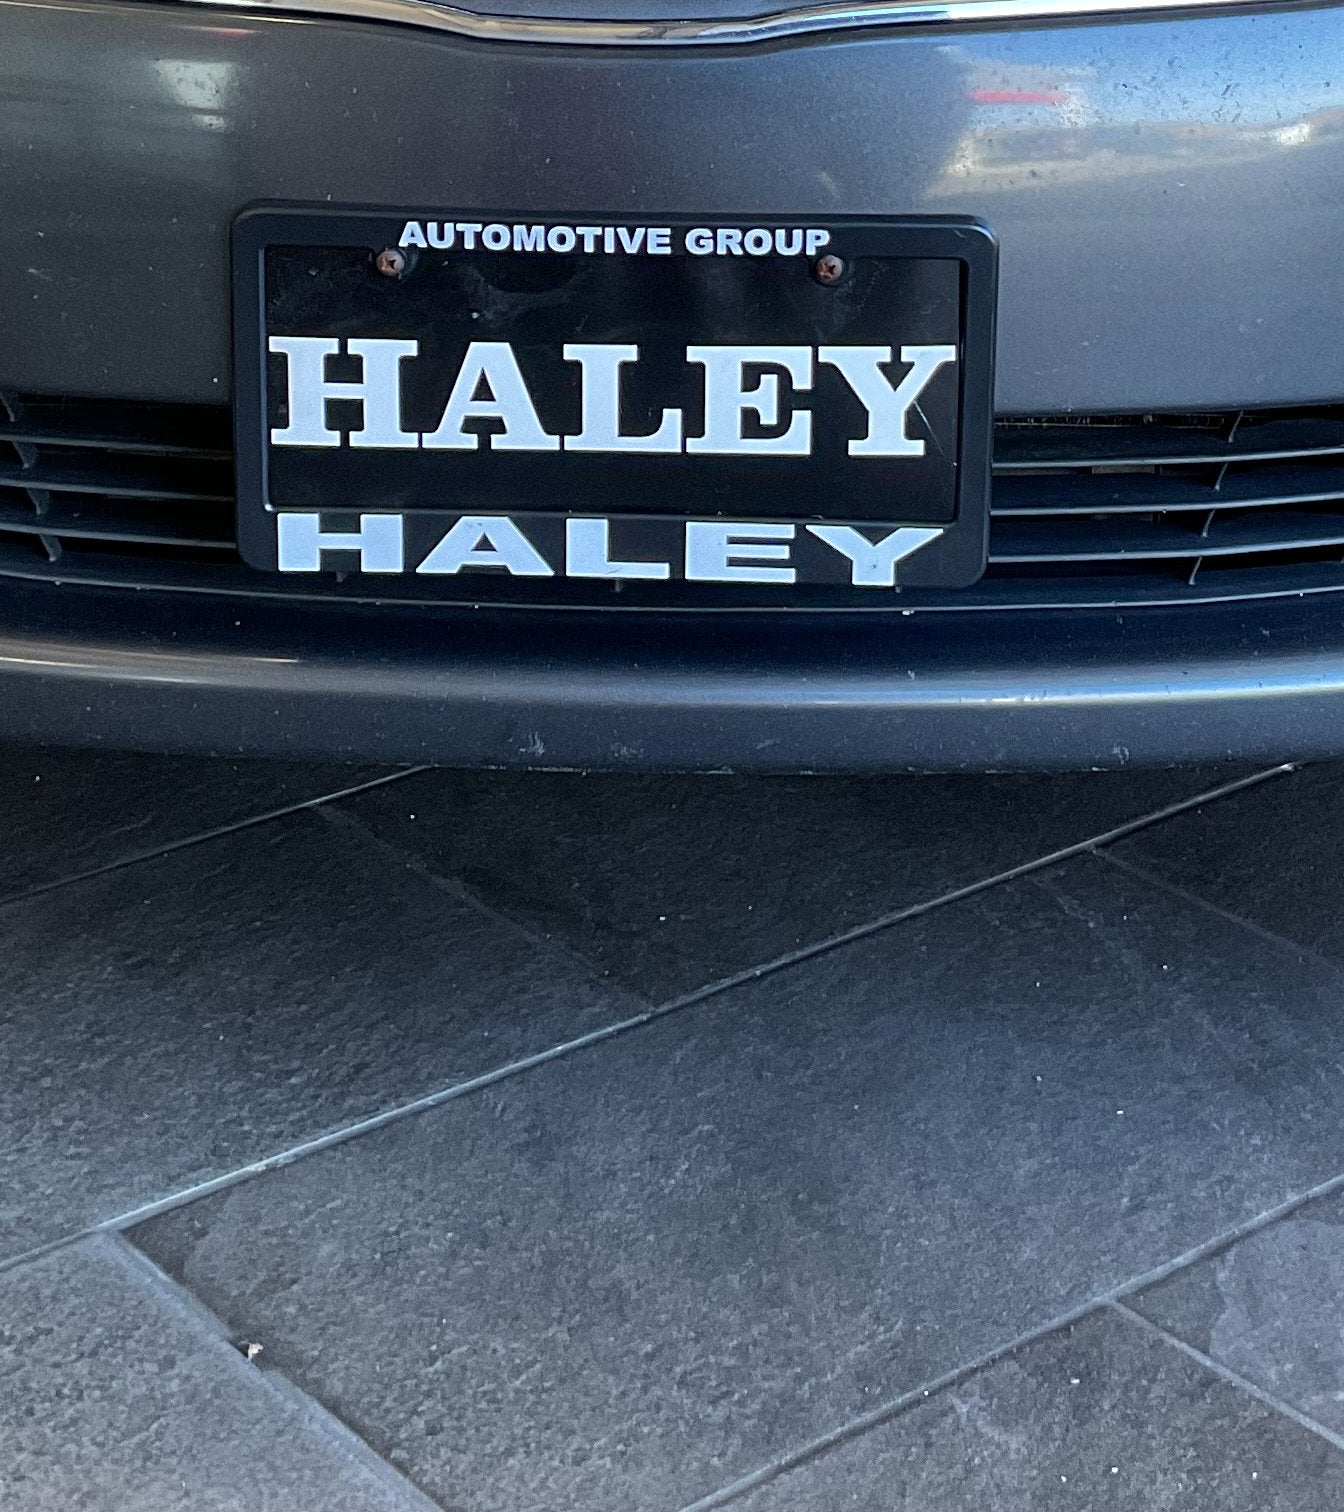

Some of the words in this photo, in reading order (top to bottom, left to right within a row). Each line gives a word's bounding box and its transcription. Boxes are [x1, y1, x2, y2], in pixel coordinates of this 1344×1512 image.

[399, 220, 672, 255] AUTOMOTIVE
[684, 227, 831, 256] GROUP
[268, 335, 957, 457] HALEY
[276, 512, 945, 587] HALEY
